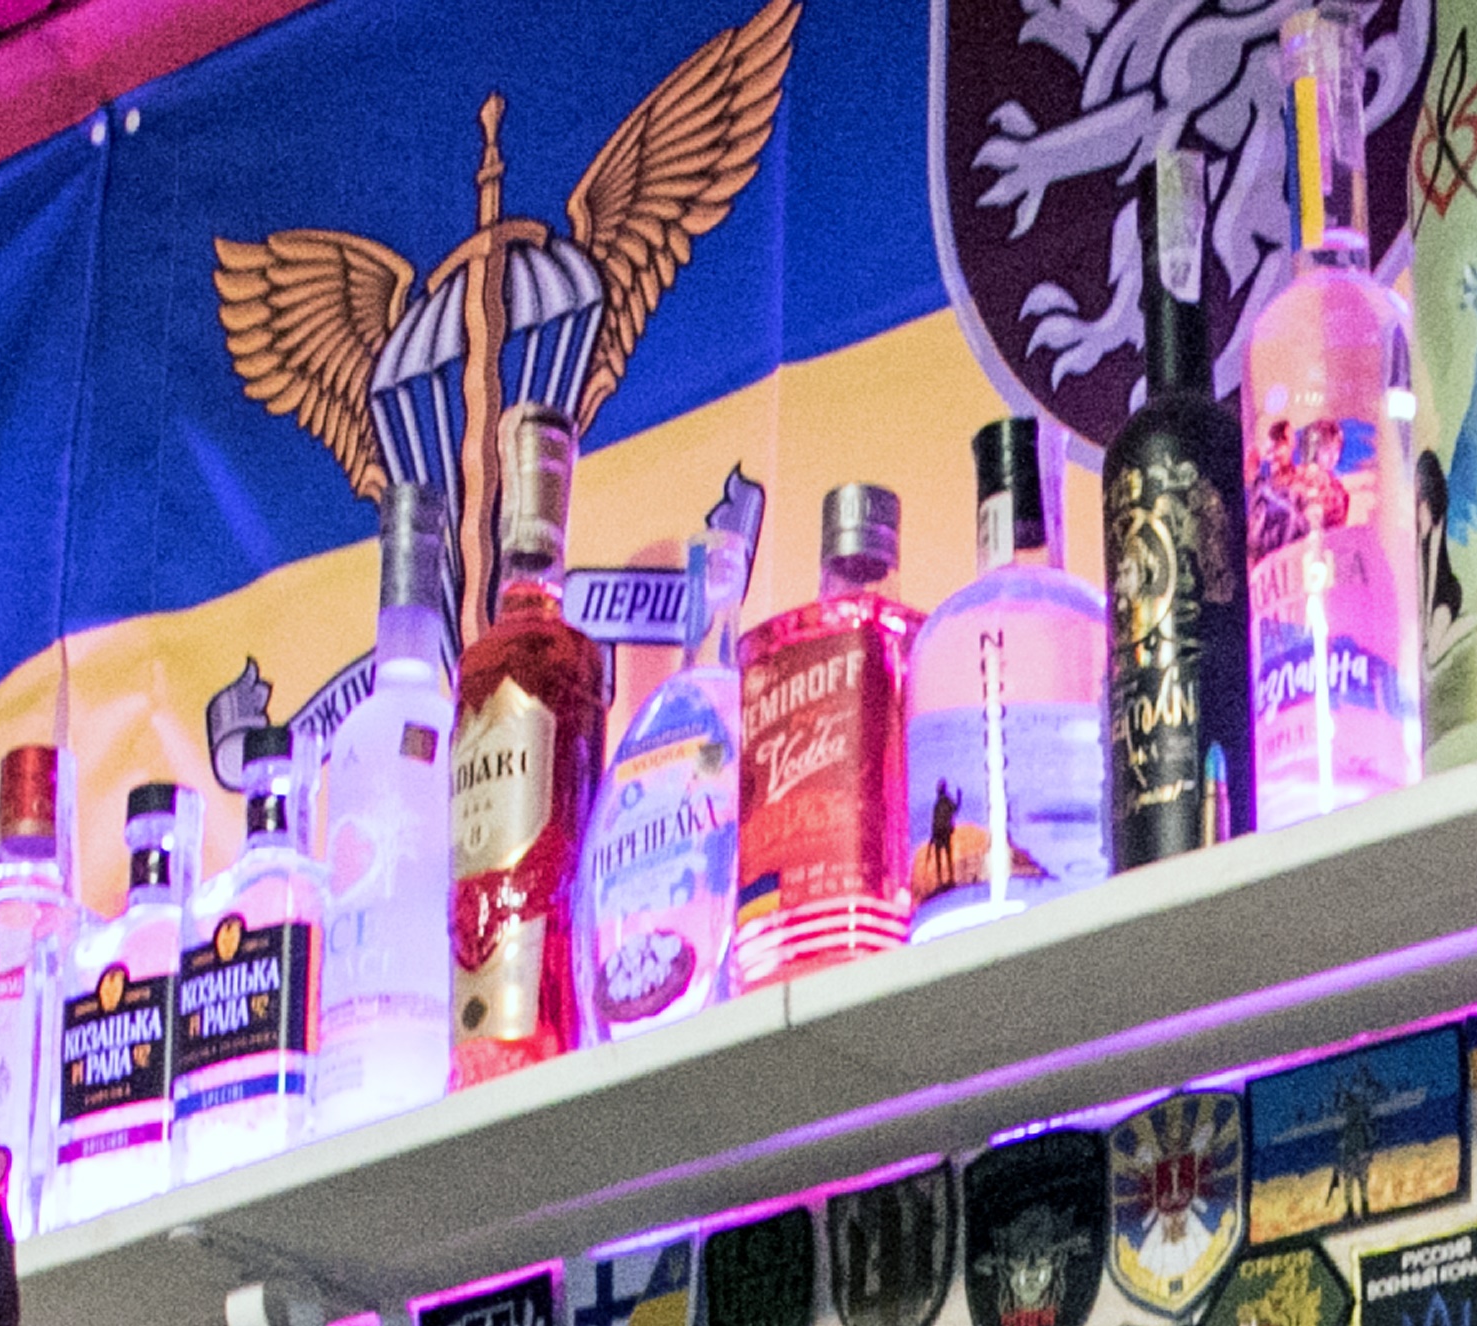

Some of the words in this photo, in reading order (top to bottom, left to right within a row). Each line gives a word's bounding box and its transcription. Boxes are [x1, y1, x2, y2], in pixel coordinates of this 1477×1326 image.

[580, 579, 692, 625] ПЕРШ
[755, 707, 850, 804] Vodka
[181, 956, 281, 1016] КОЗАЦЬКА
[64, 1005, 163, 1062] КОЗАЦЬКА
[202, 996, 250, 1039] РАДА
[84, 1044, 134, 1087] РАДА
[1401, 1236, 1473, 1270] РУССКИЙ
